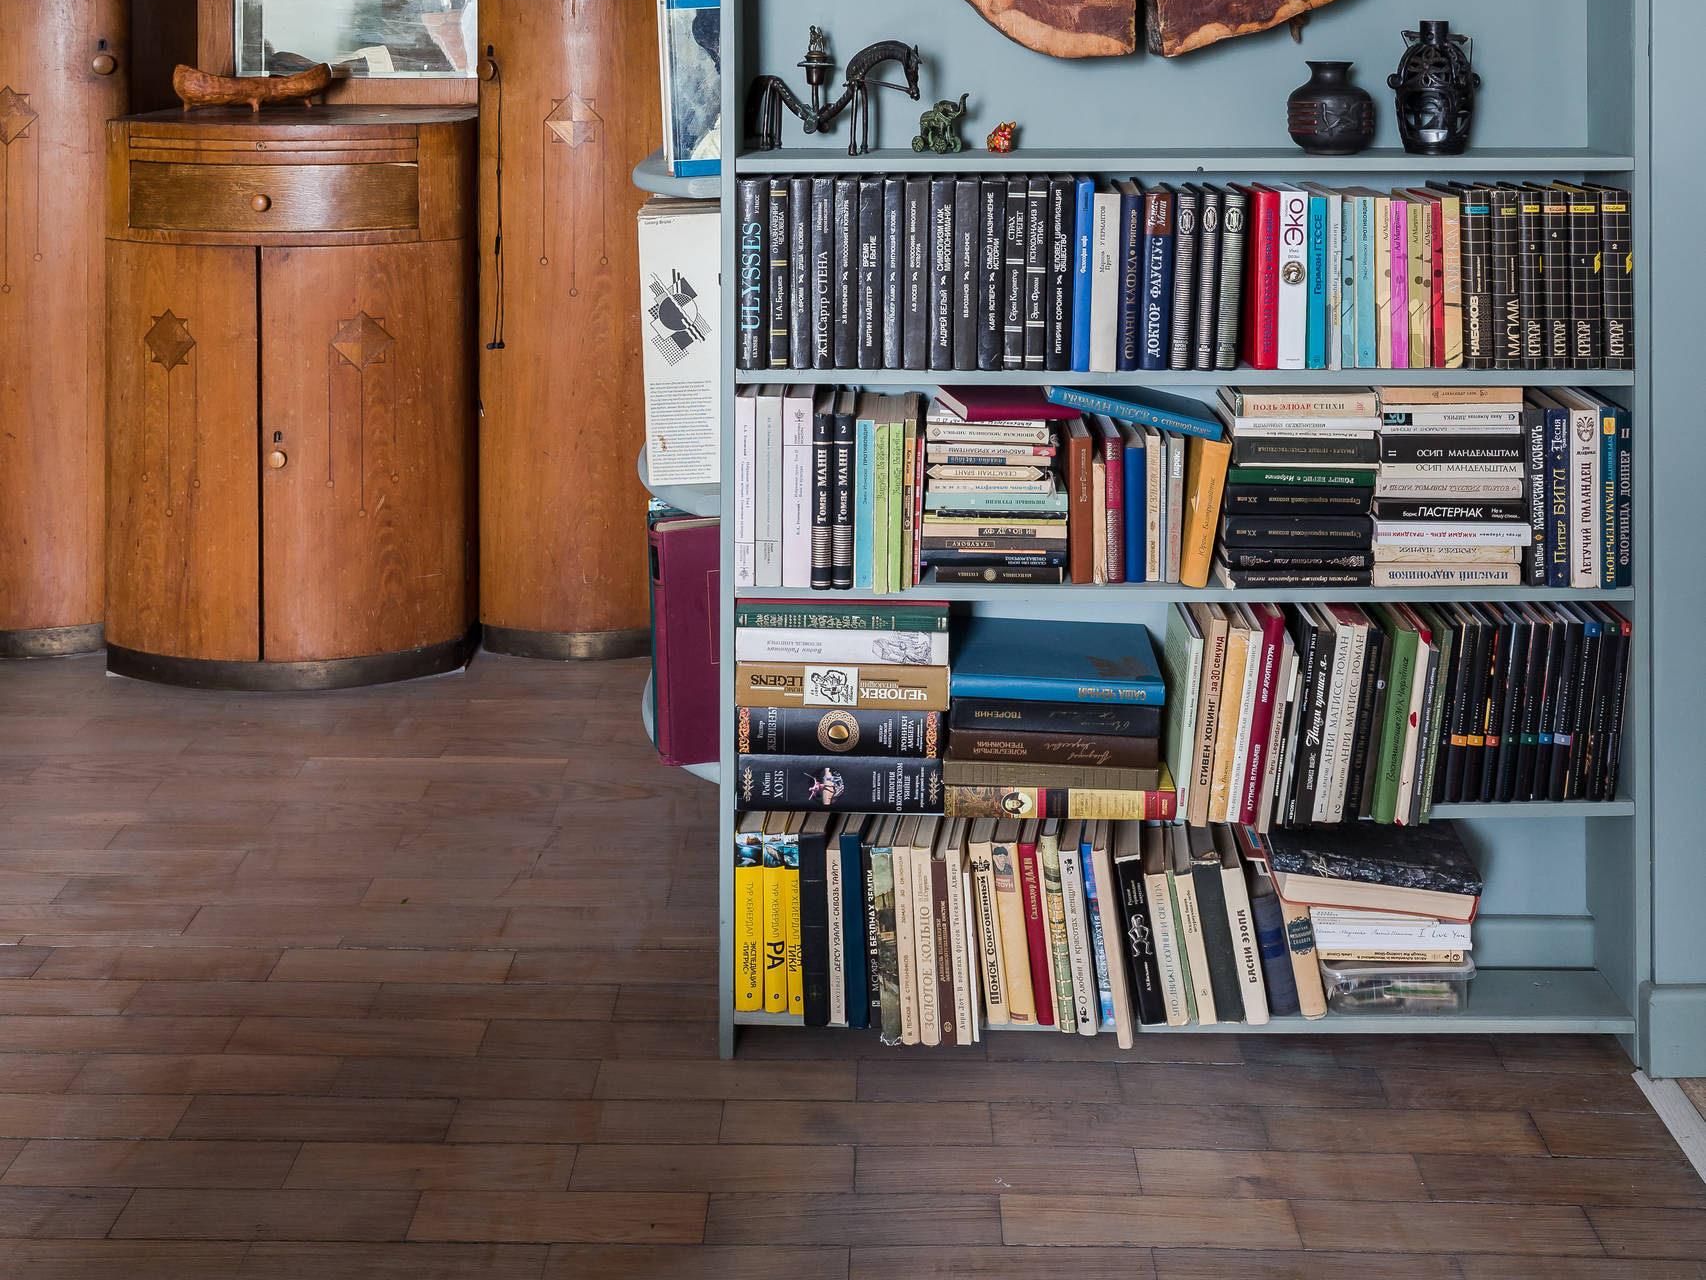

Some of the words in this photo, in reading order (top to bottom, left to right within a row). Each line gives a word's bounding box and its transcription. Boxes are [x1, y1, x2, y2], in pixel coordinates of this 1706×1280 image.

[1008, 216, 1016, 241] СТРАХ
[1015, 210, 1024, 239] ТРЕПЕТ
[1054, 189, 1062, 239] ЦИВИЛИЗАЦИЯ
[1129, 209, 1138, 247] ПРИГОВОР
[1157, 200, 1167, 226] Манн
[936, 225, 945, 272] СИМВОЛИЗМ
[943, 204, 952, 272] МИРОПОНИМАНИЕ
[1030, 209, 1038, 263] ПСИХОАНАЛИЗ
[1314, 214, 1322, 251] ГЕССЕ
[817, 251, 828, 295] СТЕНА
[1054, 241, 1062, 273] ЧЕЛОВЕК
[1149, 237, 1164, 298] ФАУСТУС
[741, 222, 762, 331] ULYSSES
[1031, 277, 1039, 301] Фромм
[1126, 256, 1138, 304] КАФКА
[1264, 272, 1273, 305] ГЕССЕ
[1313, 253, 1322, 295] Герман
[866, 286, 874, 321] ХАЙДЕГГЕР
[939, 289, 948, 315] БЕЛЫЙ
[1031, 302, 1039, 319] Эрих
[939, 317, 948, 347] АНДРЕЙ
[1055, 322, 1063, 354] ПИТИРИМ
[1124, 306, 1135, 360] ФРАНЦ
[1148, 302, 1161, 358] ДОКТОР
[1263, 309, 1273, 354] ГЕРМАН
[1470, 295, 1480, 356] НАБОКОВ
[1507, 299, 1520, 356] МИСИМА
[1527, 320, 1541, 357] КОРТАСАР
[1553, 320, 1566, 357] КОРТАСАР
[1577, 320, 1591, 357] КОРТАСАР
[1610, 320, 1624, 357] КОРТАСАР
[1063, 391, 1112, 412] ГЕРМАН
[1115, 406, 1150, 421] ГЕССЕ
[1279, 403, 1311, 411] ЭЛЮАР
[820, 426, 825, 434] 1
[841, 426, 846, 434] 2
[1551, 419, 1564, 452] Песня
[1531, 425, 1544, 470] СЛОВАРЬ
[817, 449, 827, 487] МАНН
[838, 448, 848, 487] МАНН
[1328, 476, 1354, 484] РОБЕРТ
[1620, 450, 1631, 497] ДОННЕР
[817, 491, 827, 524] Томас
[838, 490, 848, 523] Томас
[1531, 474, 1544, 530] ХАЗАРСКИЙ
[1553, 468, 1565, 516] БИГЛ
[1581, 461, 1592, 523] ГОЛЛАНДЕЦ
[1418, 506, 1483, 518] ПАСТЕРНАК
[1554, 519, 1567, 563] Питер
[1620, 502, 1630, 565] ФЛОРИНДА
[1388, 569, 1455, 579] АНДРОНИКОВ
[1459, 570, 1508, 582] ИРАКЛИЙ
[1213, 636, 1225, 669] секунд
[1263, 644, 1275, 688] АРХИТЕКТУРЫ
[750, 674, 804, 687] LEGENS
[1210, 669, 1220, 681] 30
[1210, 681, 1218, 692] за
[860, 688, 928, 700] ЧЕЛОВЕК
[1261, 688, 1269, 703] МИР
[1305, 710, 1322, 747] Нагим
[1319, 654, 1327, 670] я
[974, 711, 1023, 719] ТВОРЕНИЯ
[1203, 699, 1216, 741] ХОКИНГ
[1275, 702, 1283, 720] Land
[900, 716, 909, 751] ХРОНИКИ
[907, 720, 915, 749] АМБЕРА
[976, 741, 1025, 749] ТРЕНОЖНИК
[1270, 720, 1283, 755] Legendary
[973, 747, 1027, 755] КОЛЕБЛЕМЫЙ
[1200, 745, 1212, 786] СТИВЕН
[1308, 752, 1317, 769] ВЕЙС
[762, 772, 771, 796] Робин
[774, 770, 784, 799] ХОББ
[904, 775, 912, 801] УБИЙЦЕ
[1306, 769, 1315, 791] ДЭВИД
[791, 879, 799, 894] ТУР
[1023, 857, 1035, 885] ДАЛИ
[832, 887, 840, 917] СКВОЗЬ
[1028, 884, 1039, 920] Сальвадор
[1067, 881, 1077, 915] женщин
[1154, 884, 1167, 920] СВЕТИЛА
[746, 896, 755, 937] ХЕЙЕРДАЛ
[772, 899, 780, 939] ХЕЙЕРДАЛ
[791, 896, 800, 940] ХЕЙЕРДАЛ
[977, 876, 995, 955] СОКРОВЕННЫЙ
[1237, 909, 1250, 944] ЭЗОПА
[833, 921, 841, 947] УЗАЛА
[919, 906, 932, 963] КОЛЬЦО
[1071, 917, 1081, 955] красотах
[1162, 931, 1173, 963] СОЛНЦЕ
[742, 942, 750, 975] «ТИГРИС»
[766, 941, 785, 970] РА
[788, 944, 797, 973] ТИКИ
[834, 948, 842, 972] ДЕРСУ
[1244, 946, 1257, 983] БАСНИ
[1076, 967, 1086, 994] любви
[1166, 964, 1179, 1000] ДВИЖЕТ
[922, 968, 935, 1030] ЗОЛОТОЕ
[1079, 996, 1087, 1004] О
[1171, 1000, 1180, 1017] ЧТО
